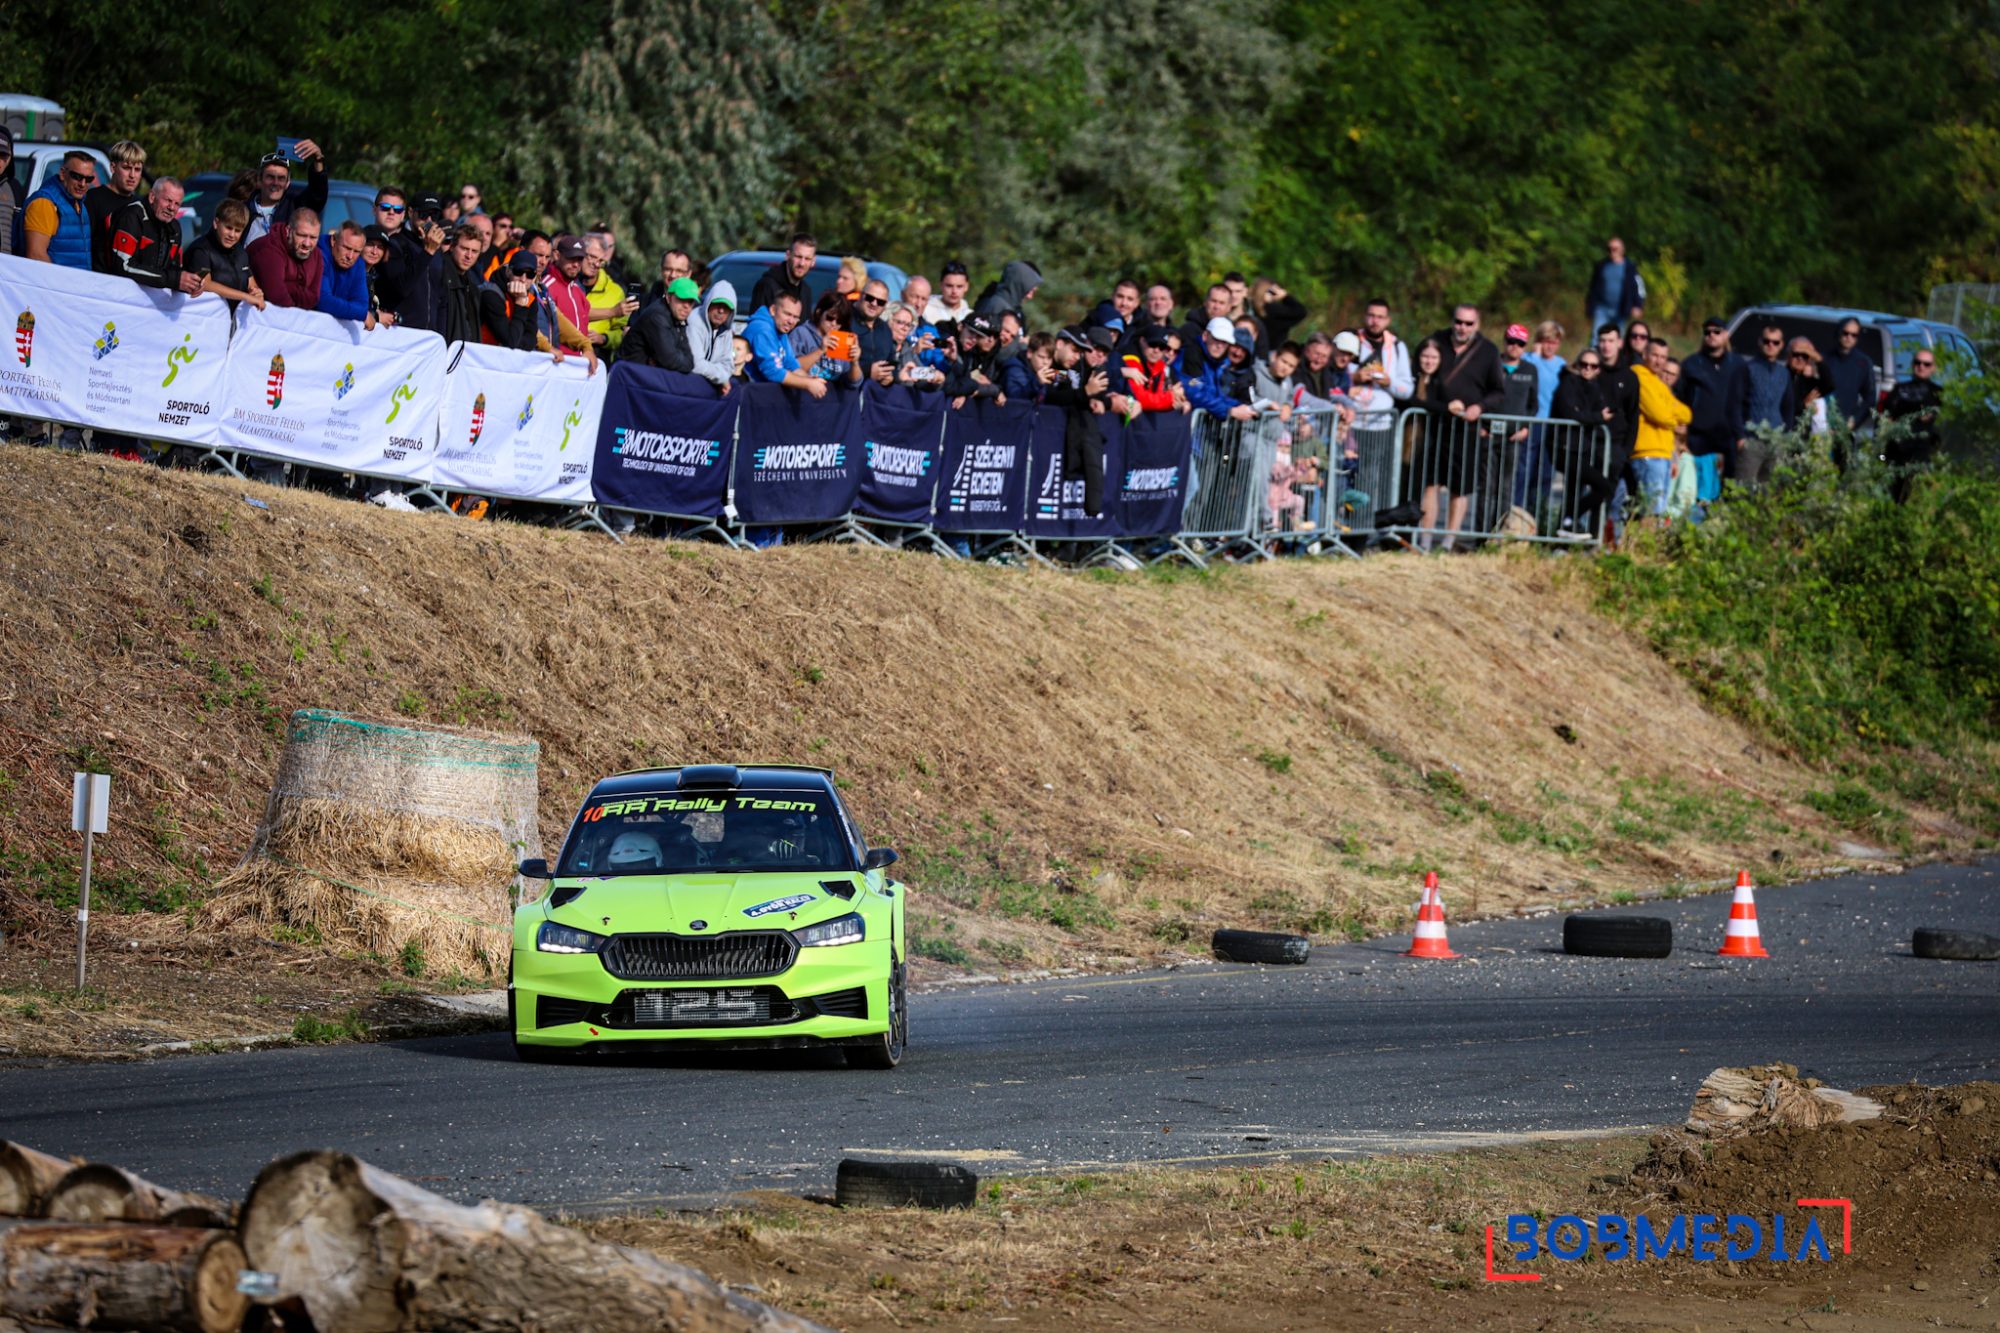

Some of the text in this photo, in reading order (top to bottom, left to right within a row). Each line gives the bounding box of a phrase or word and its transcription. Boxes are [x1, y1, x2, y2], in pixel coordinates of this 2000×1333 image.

[166, 400, 210, 415] SPORTOLÓ
[158, 412, 191, 426] NEMZET
[389, 435, 424, 451] SPORTOLÓ
[627, 430, 706, 465] MOTORSPORT
[383, 449, 408, 461] NEMZET
[762, 444, 841, 469] MOTORSPORT
[799, 469, 847, 481] UNIVERSITY
[653, 798, 727, 813] Rally
[735, 797, 816, 813] Team
[583, 806, 605, 823] 10
[645, 990, 757, 1021] 125
